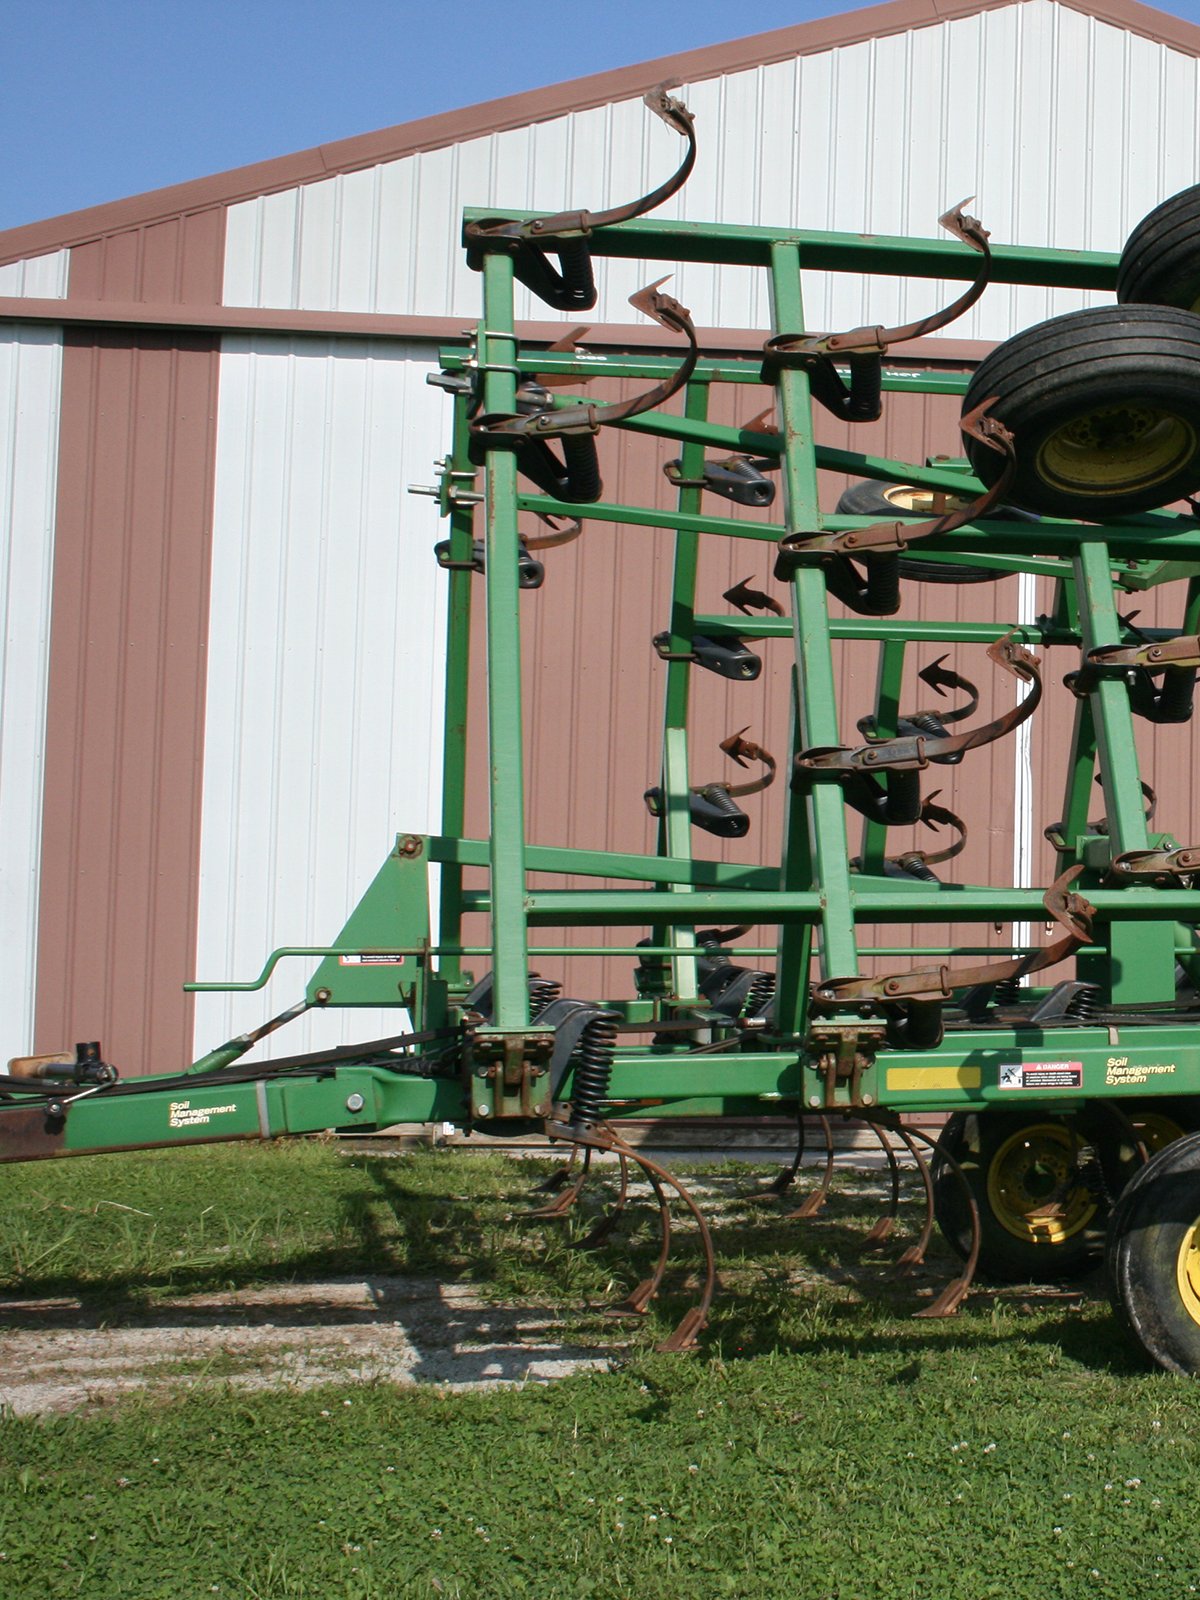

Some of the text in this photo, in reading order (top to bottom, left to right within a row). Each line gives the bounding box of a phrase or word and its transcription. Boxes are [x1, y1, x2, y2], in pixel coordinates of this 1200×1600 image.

[1106, 1057, 1128, 1067] Soil
[1106, 1064, 1176, 1076] Management
[1105, 1075, 1147, 1086] System
[170, 1100, 190, 1111] Soil
[170, 1104, 237, 1119] Management
[169, 1116, 210, 1127] System
